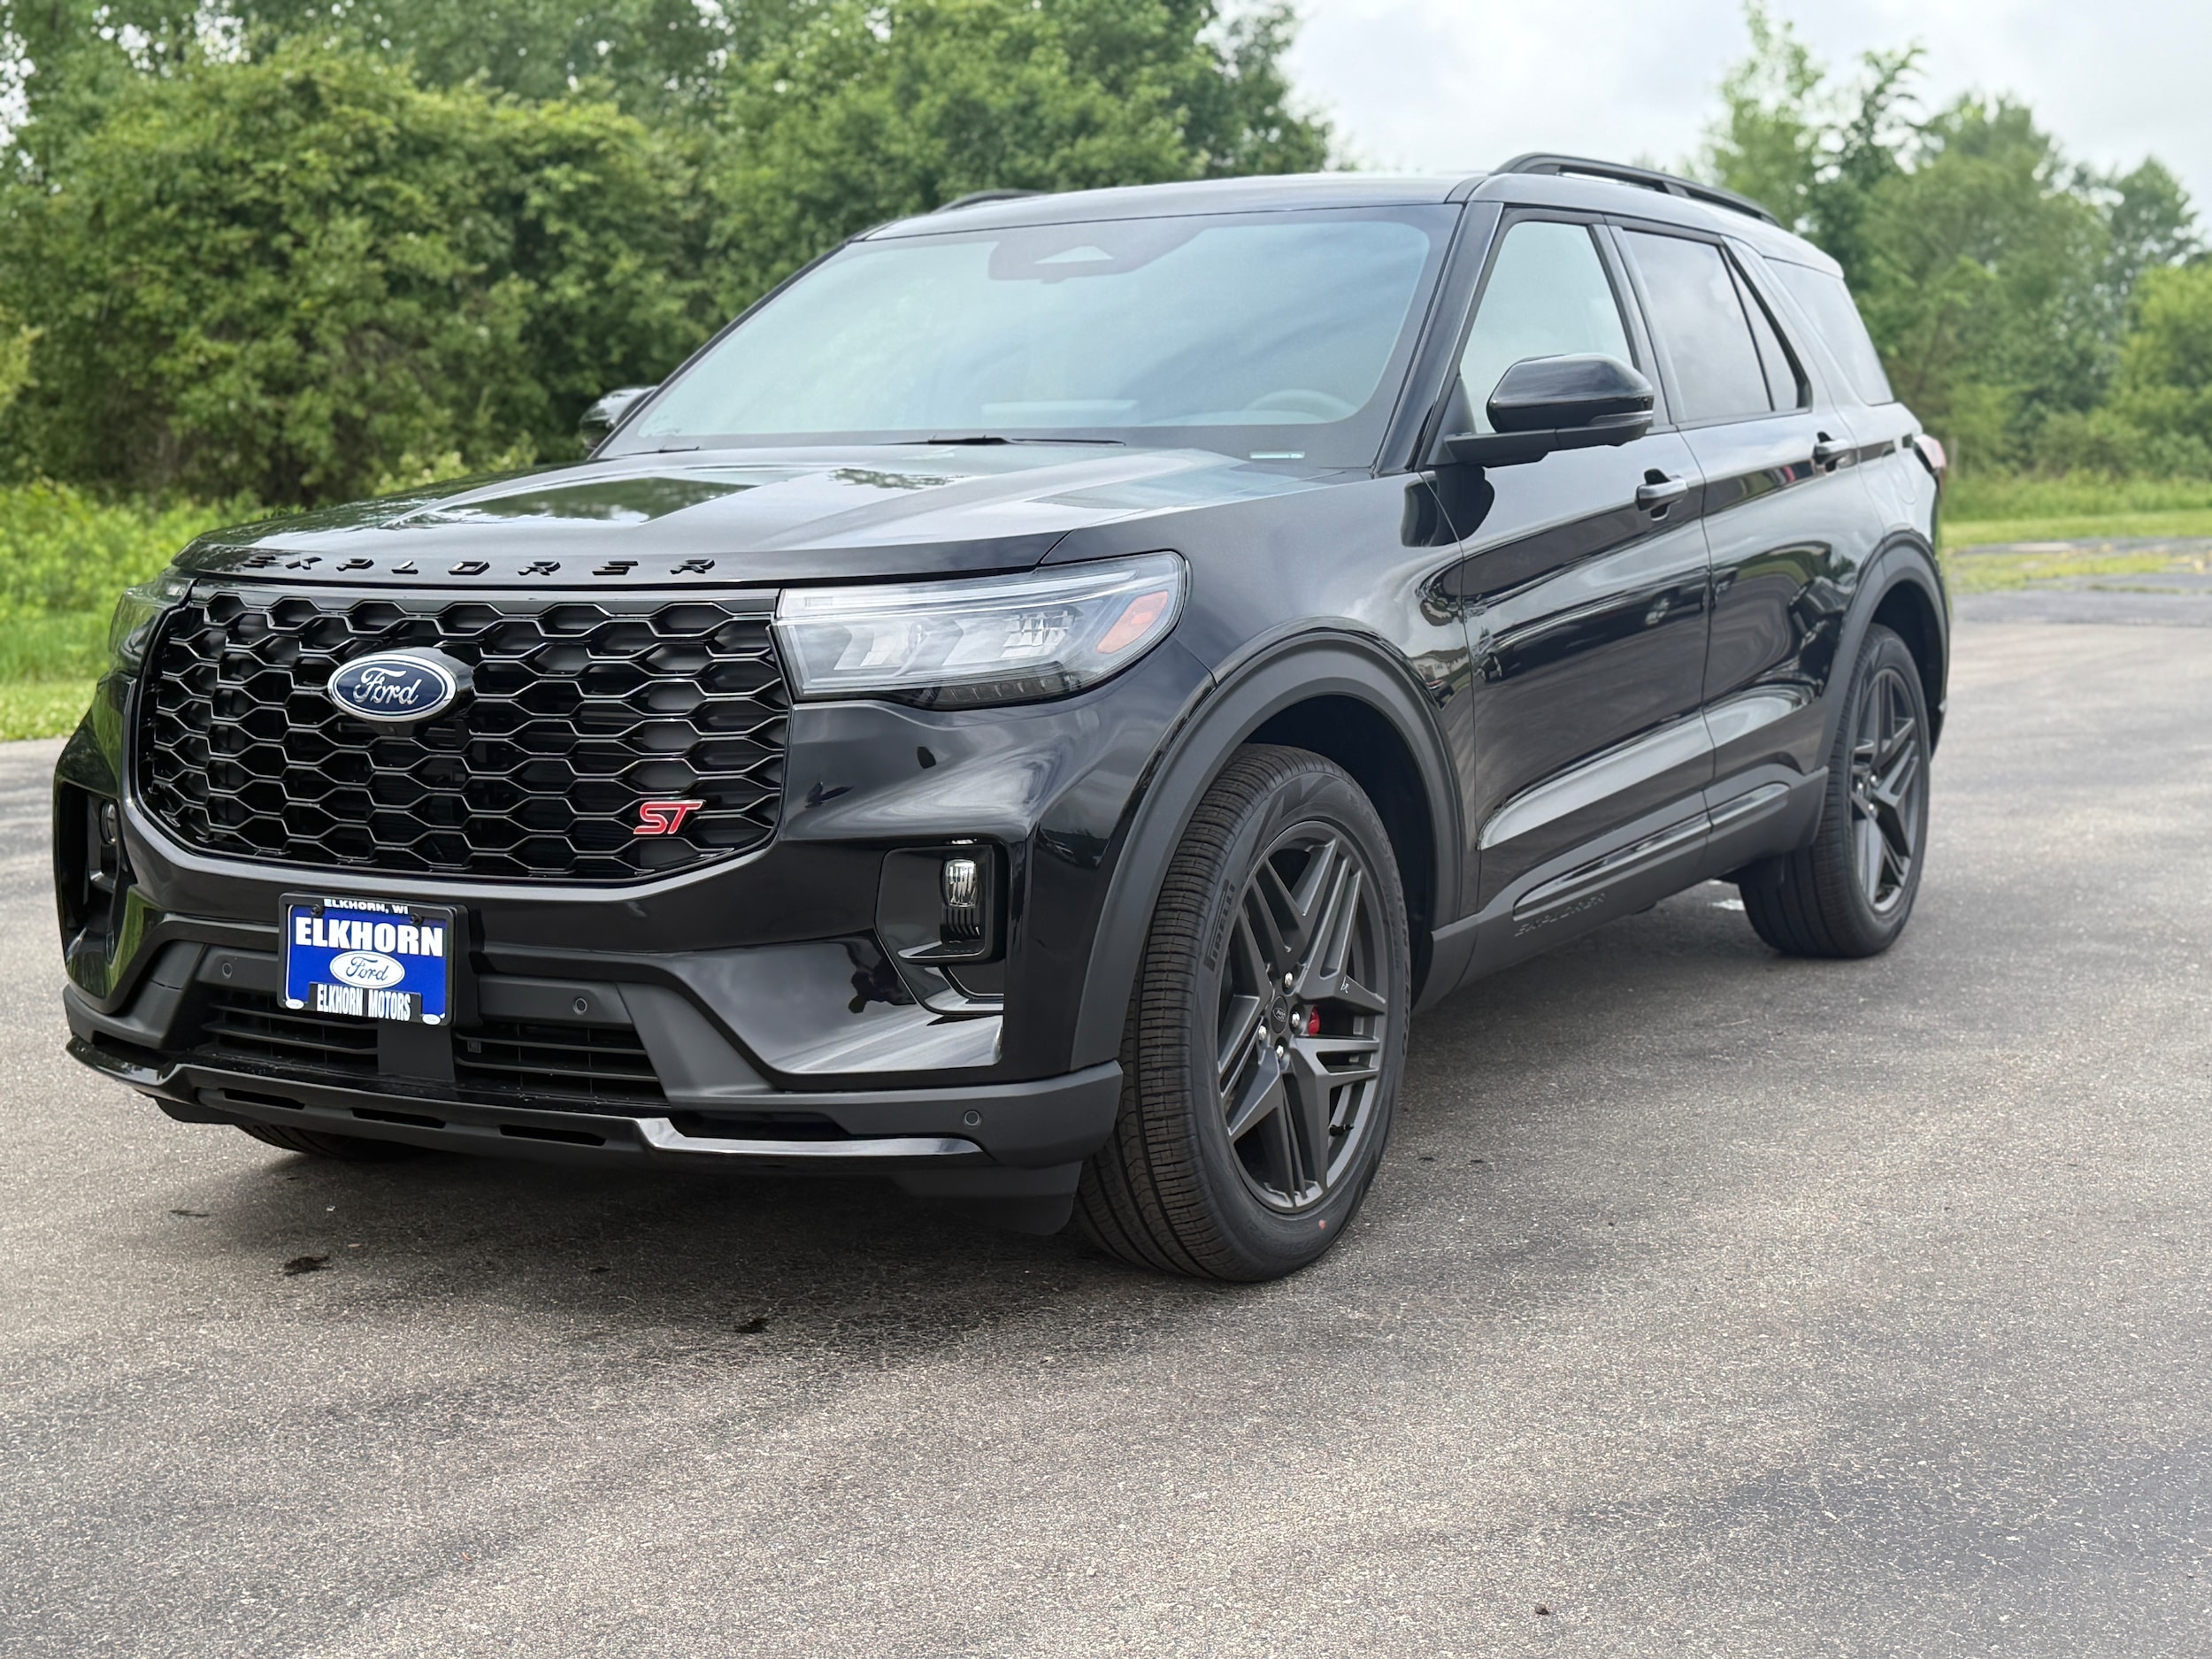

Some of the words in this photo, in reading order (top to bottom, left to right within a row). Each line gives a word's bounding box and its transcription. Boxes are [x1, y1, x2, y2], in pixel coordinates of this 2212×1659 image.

[242, 555, 715, 576] EXPLORER
[354, 667, 423, 705] Ford
[633, 800, 704, 834] ST
[324, 898, 389, 914] ELKHORN,
[392, 904, 409, 915] WI
[296, 917, 443, 957] ELKHORN
[1203, 879, 1235, 972] PIRELLI
[346, 956, 388, 981] Ford
[317, 984, 364, 1017] ELKHORN
[368, 989, 411, 1022] MOTORS
